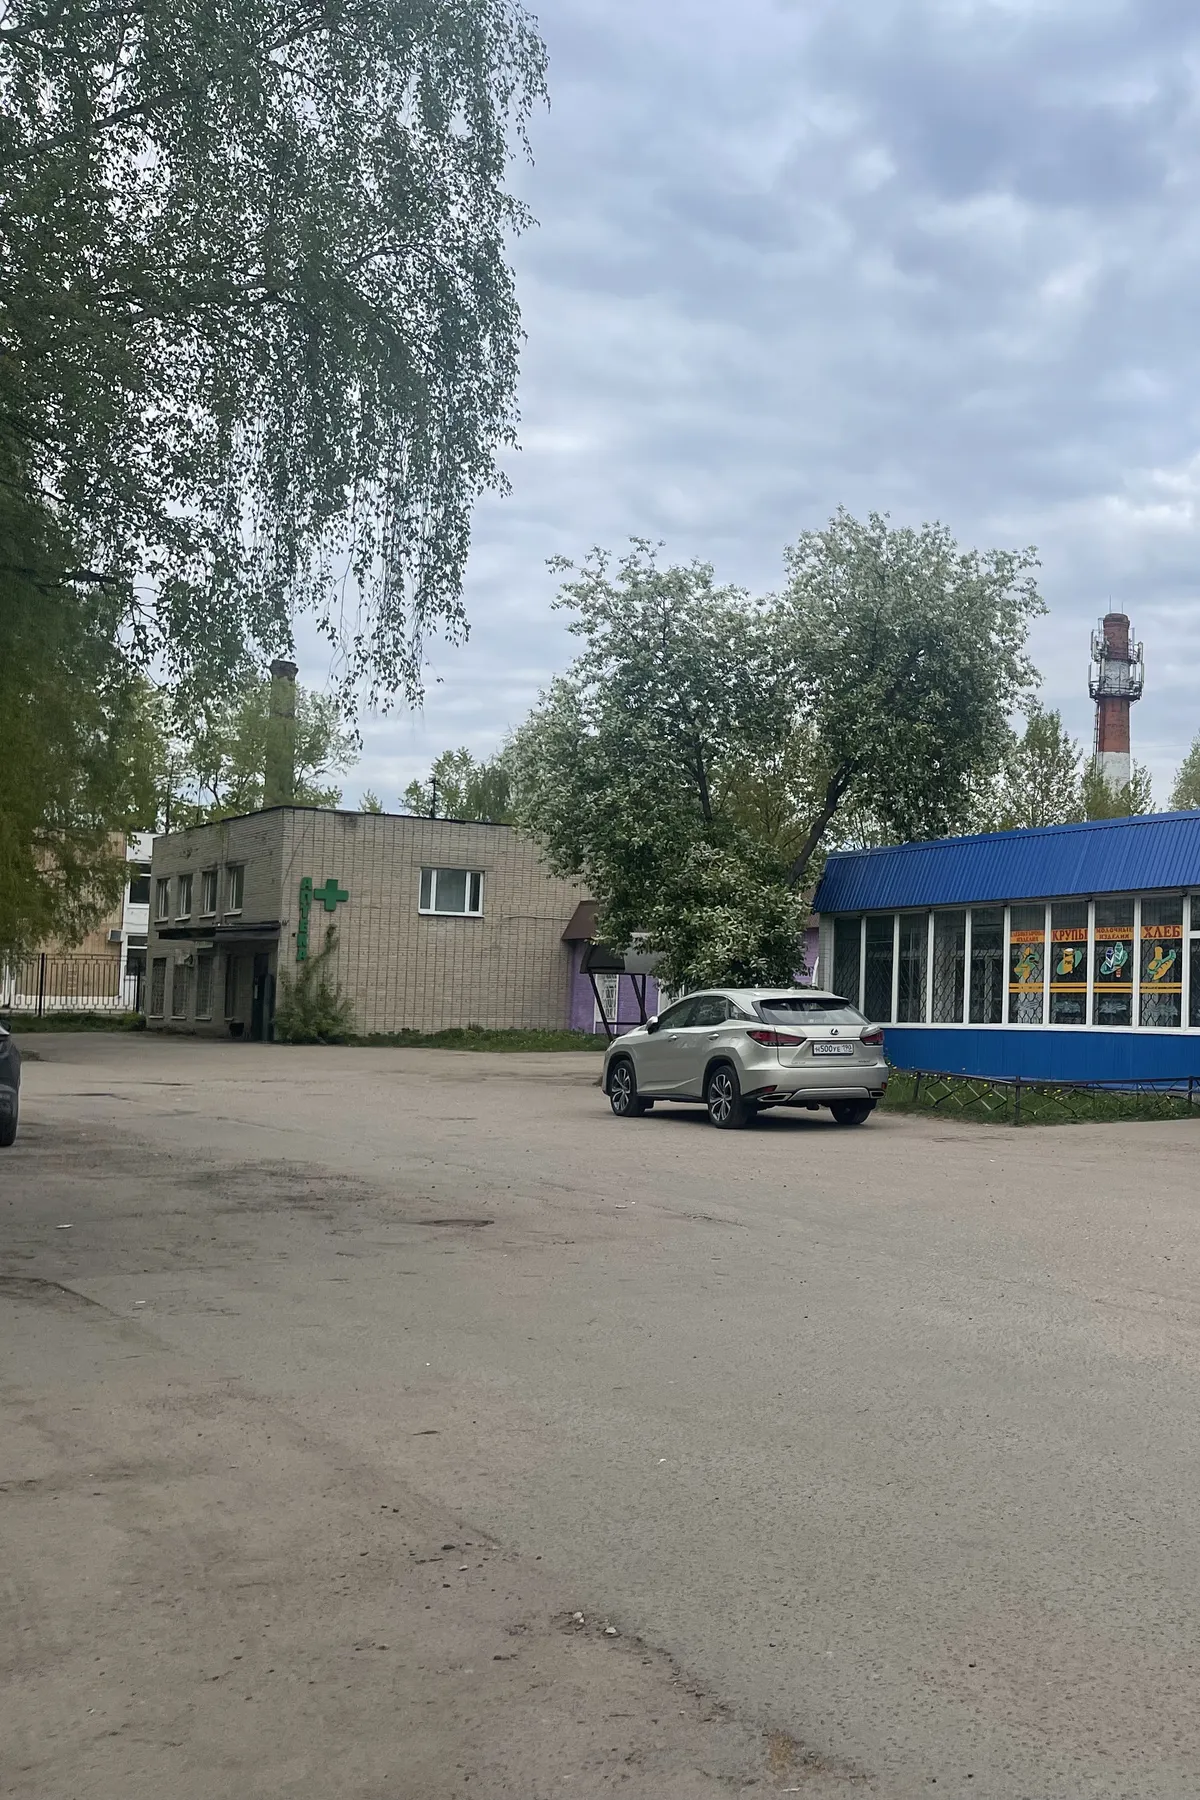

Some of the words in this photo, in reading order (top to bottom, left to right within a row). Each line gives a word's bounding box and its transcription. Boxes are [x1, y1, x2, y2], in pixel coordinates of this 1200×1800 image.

[296, 877, 312, 961] АПТЕКА
[1052, 929, 1088, 941] КРУПЫ
[1143, 925, 1180, 938] ХЛЕБ
